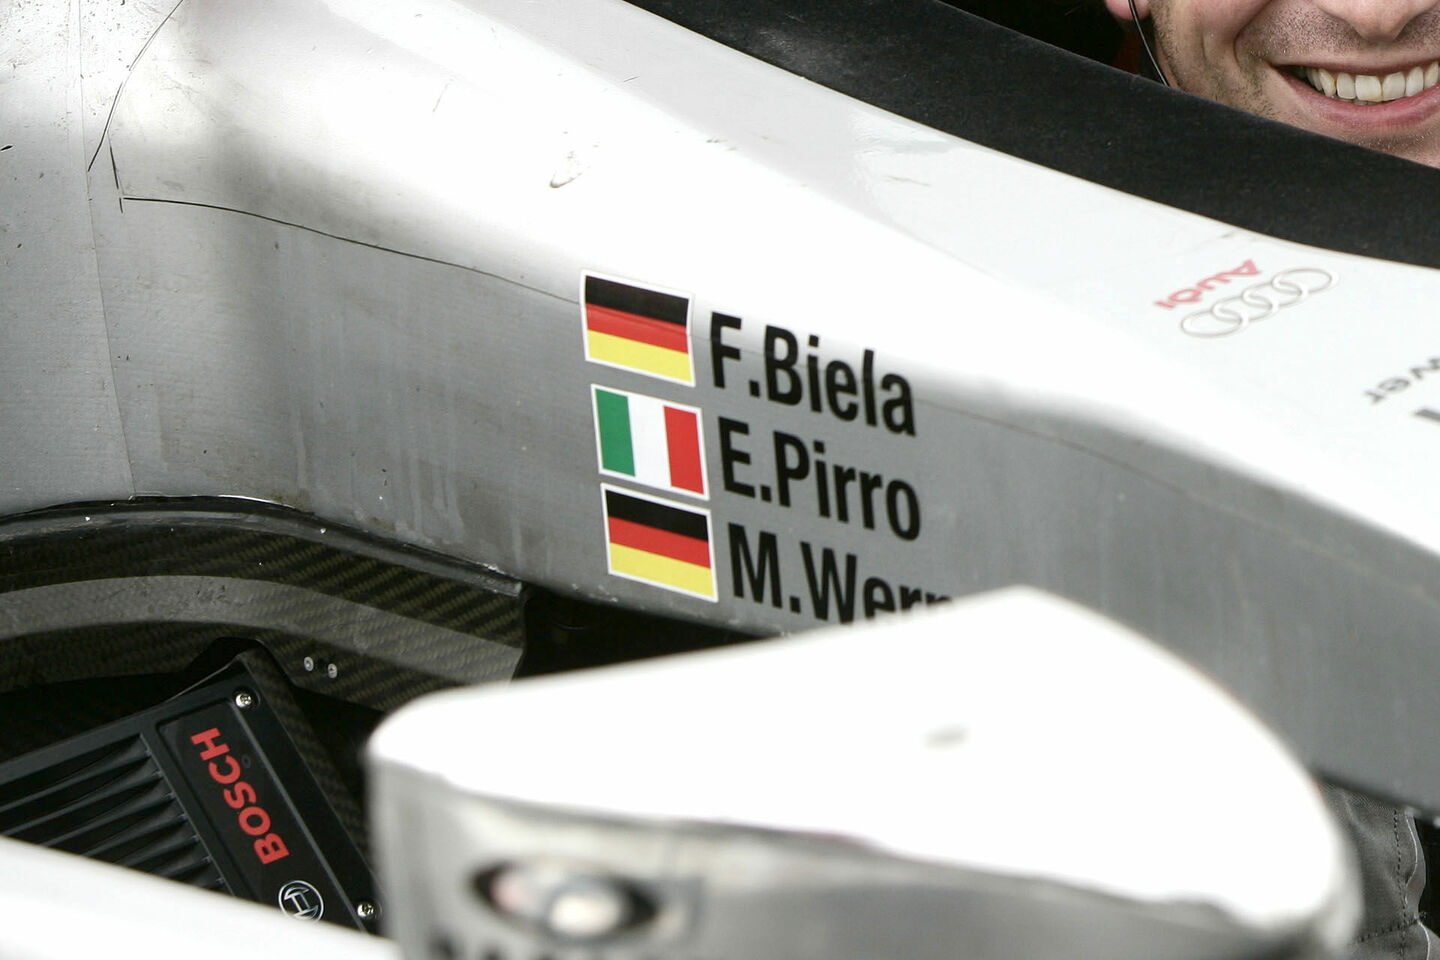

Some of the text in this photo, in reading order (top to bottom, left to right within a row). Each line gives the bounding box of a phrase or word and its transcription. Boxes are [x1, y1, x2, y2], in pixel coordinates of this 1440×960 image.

[710, 311, 916, 437] F.Biela
[718, 416, 921, 541] E.Pirro
[190, 727, 291, 865] BOSCH
